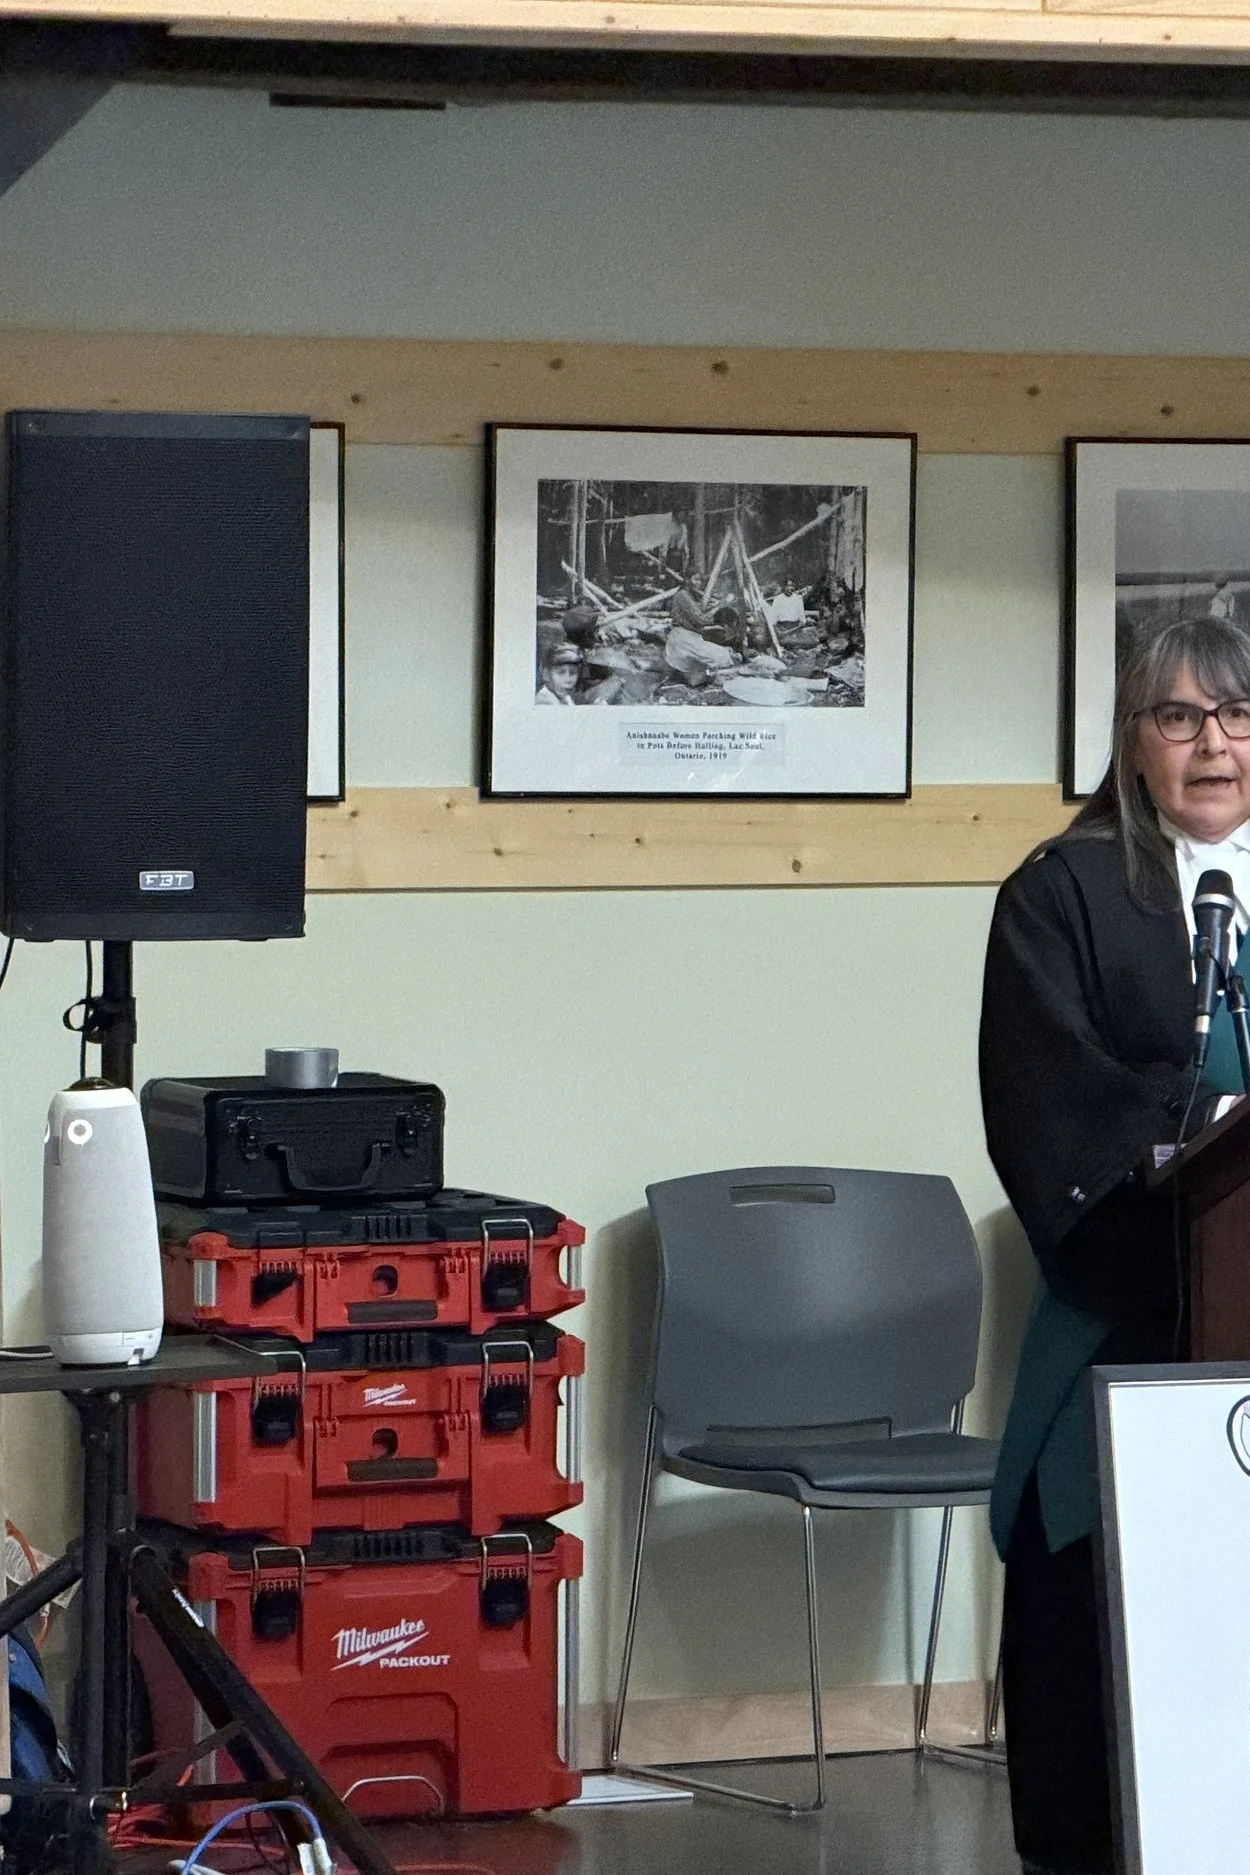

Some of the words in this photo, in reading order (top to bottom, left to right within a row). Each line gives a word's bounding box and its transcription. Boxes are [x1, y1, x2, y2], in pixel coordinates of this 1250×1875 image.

[672, 731, 700, 740] Women
[702, 731, 736, 741] Parching
[739, 731, 757, 740] Wild
[636, 742, 645, 750] in
[647, 741, 664, 750] Pots
[666, 741, 692, 750] Before
[728, 742, 743, 750] Lac
[674, 752, 706, 760] Ontario,
[709, 752, 728, 760] 1919
[145, 874, 188, 887] FBT
[331, 1618, 425, 1660] Milwaukee
[379, 1655, 451, 1669] PACKOUT
